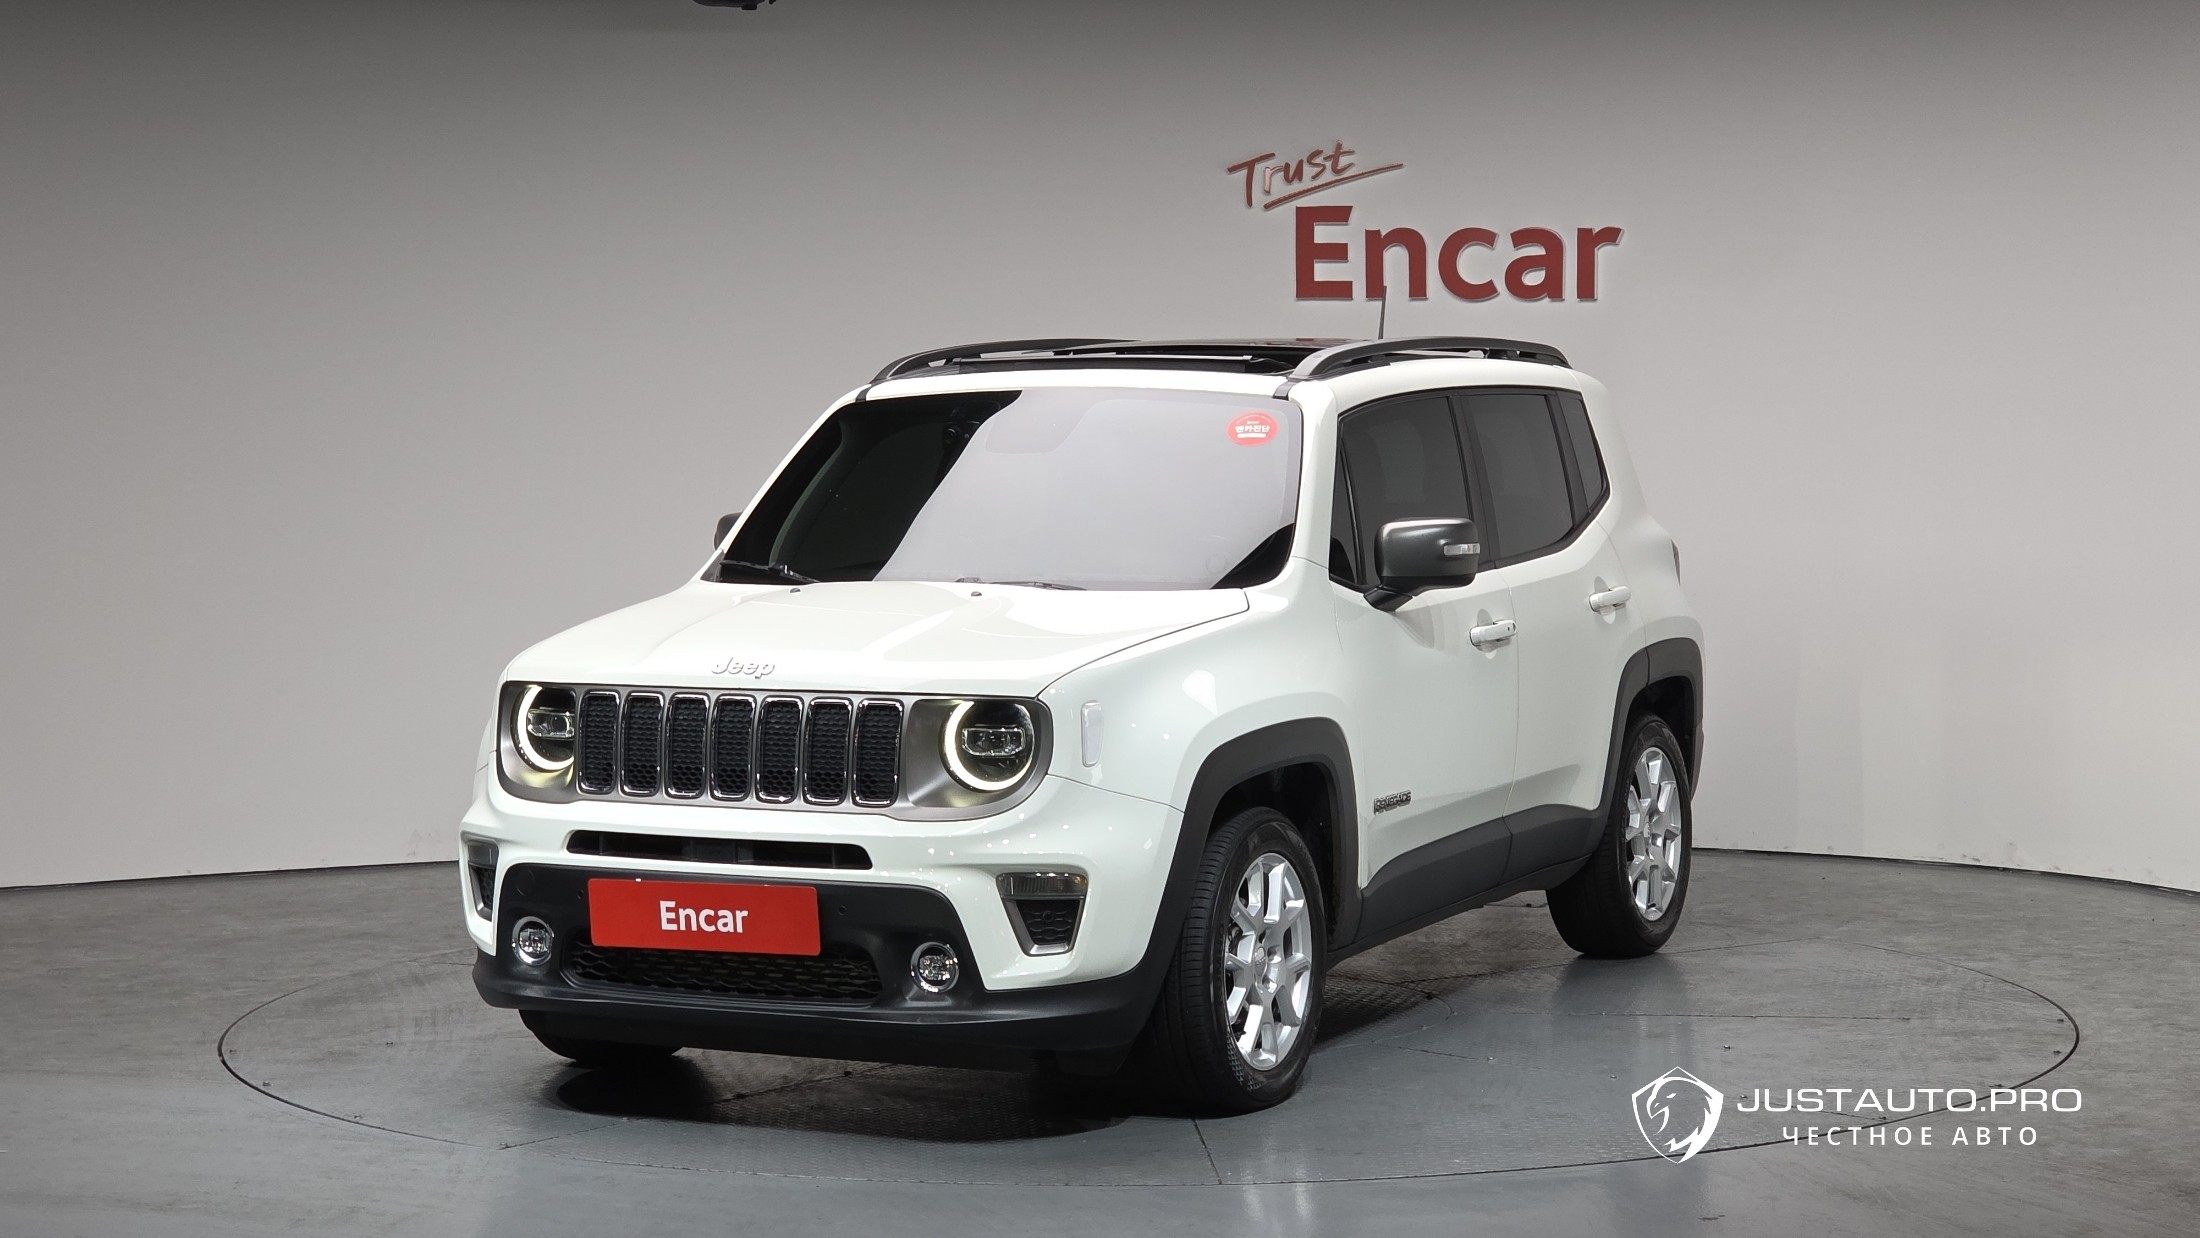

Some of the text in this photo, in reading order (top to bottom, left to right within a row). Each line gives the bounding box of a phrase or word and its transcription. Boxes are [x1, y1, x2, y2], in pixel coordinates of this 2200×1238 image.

[1227, 140, 1355, 208] Trust
[1295, 205, 1625, 301] Encar
[711, 657, 775, 680] Jeep
[659, 900, 748, 933] Encar
